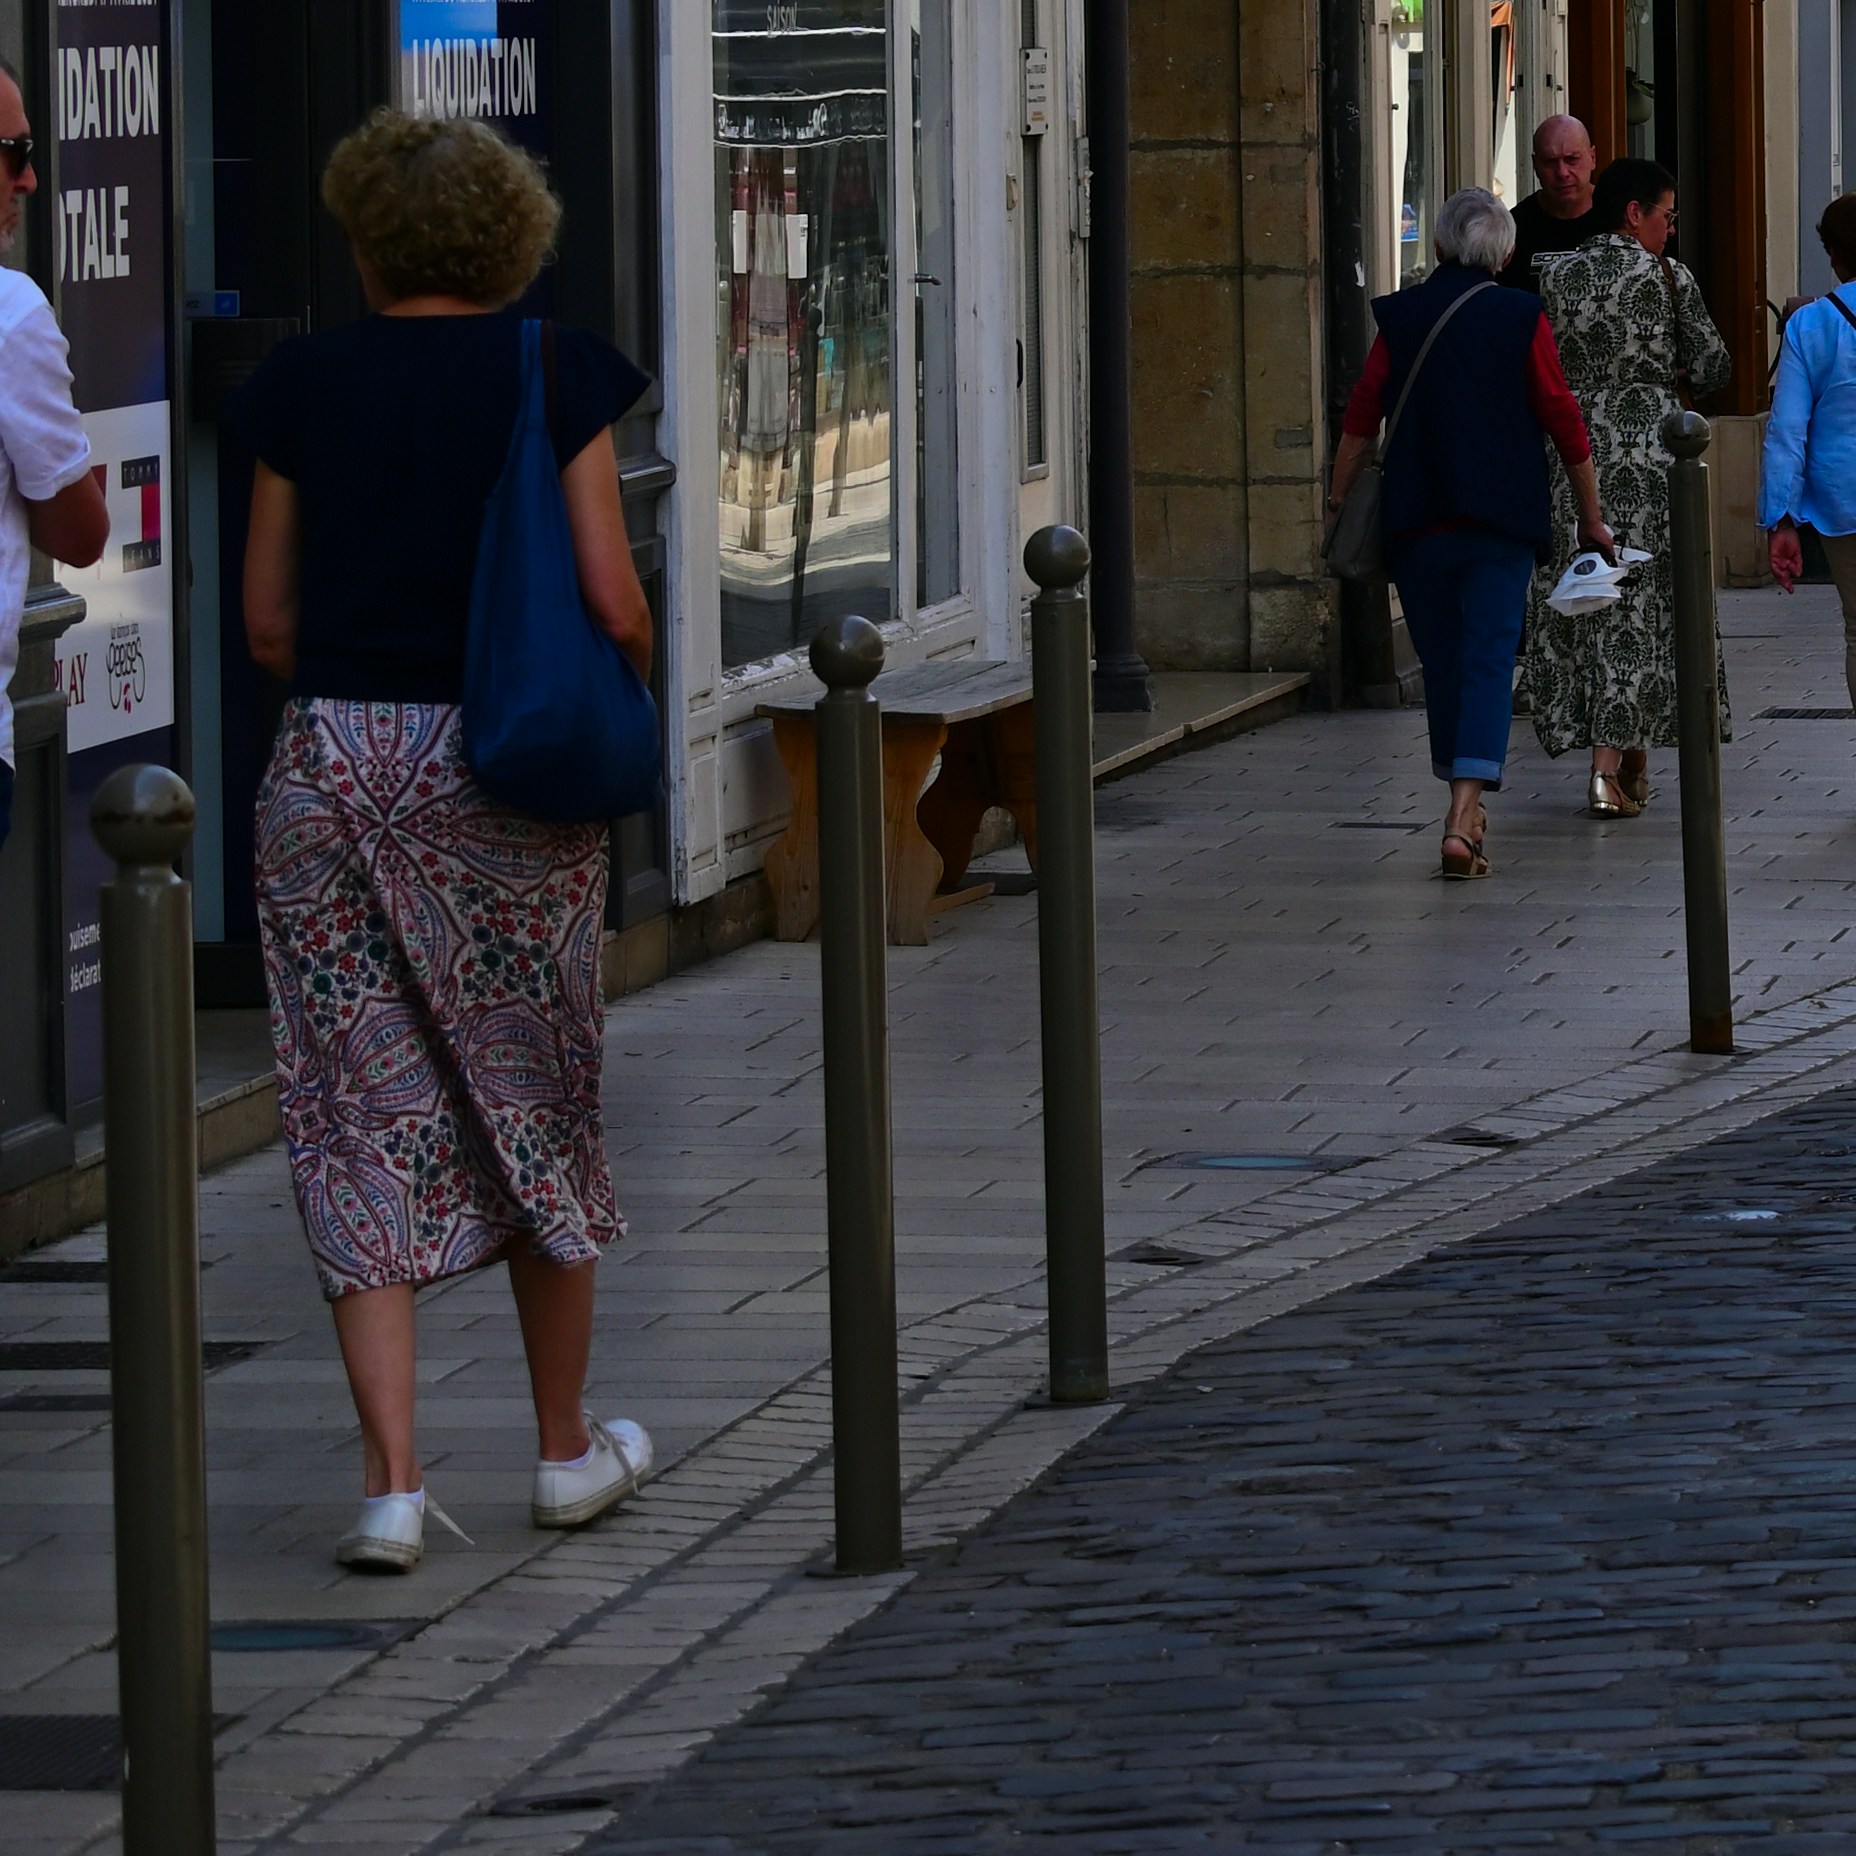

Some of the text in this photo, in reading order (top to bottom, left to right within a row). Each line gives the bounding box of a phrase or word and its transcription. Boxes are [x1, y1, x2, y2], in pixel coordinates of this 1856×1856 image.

[412, 37, 537, 123] LIQUIDATION
[59, 186, 130, 284] TALE
[123, 461, 159, 482] TOMMY
